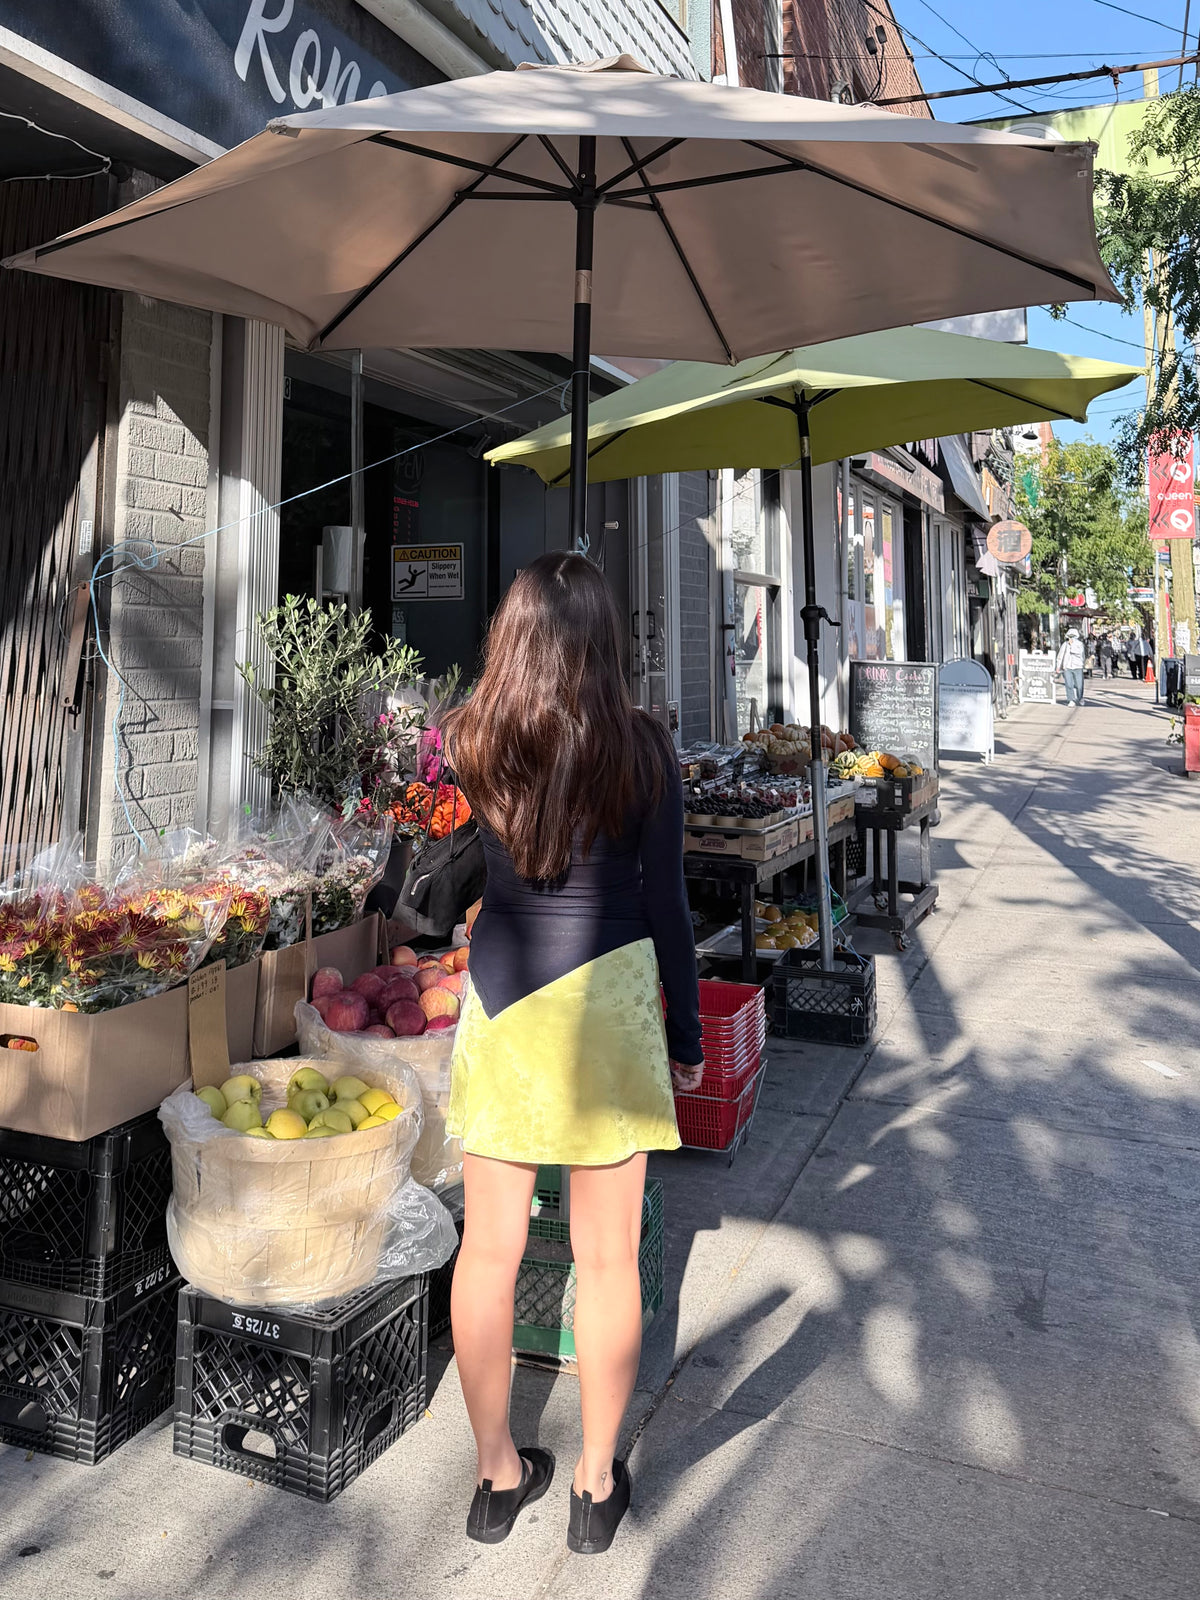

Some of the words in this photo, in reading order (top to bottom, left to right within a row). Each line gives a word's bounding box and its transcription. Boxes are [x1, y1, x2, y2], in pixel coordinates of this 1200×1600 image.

[410, 548, 457, 560] CAUTION
[431, 562, 457, 571] Slippery
[429, 572, 446, 580] When
[447, 571, 459, 579] Wet
[245, 1317, 281, 1340] 37/25
